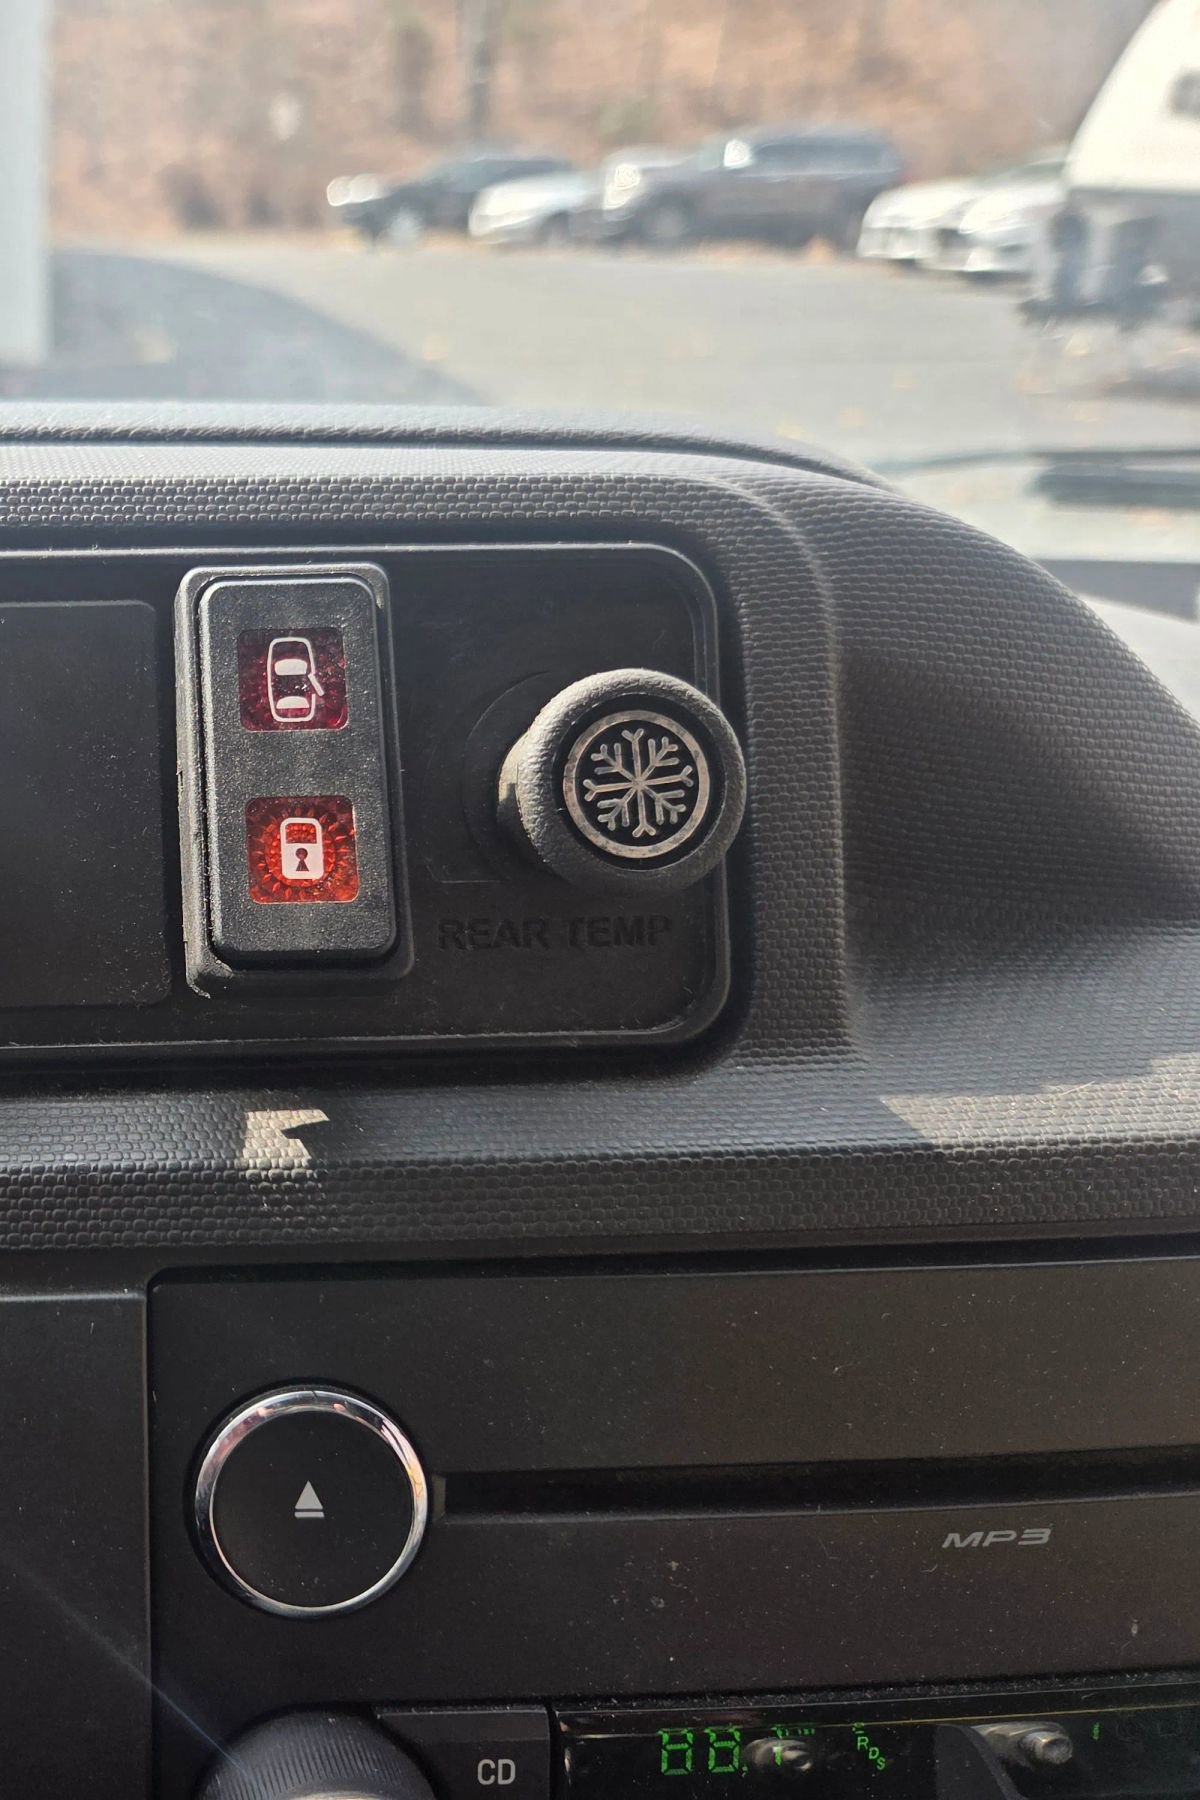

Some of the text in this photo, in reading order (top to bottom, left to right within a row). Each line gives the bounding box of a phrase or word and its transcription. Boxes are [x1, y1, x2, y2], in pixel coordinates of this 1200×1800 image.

[437, 913, 672, 950] REAR TEMP
[941, 1527, 1052, 1549] MP3
[477, 1758, 516, 1785] CD
